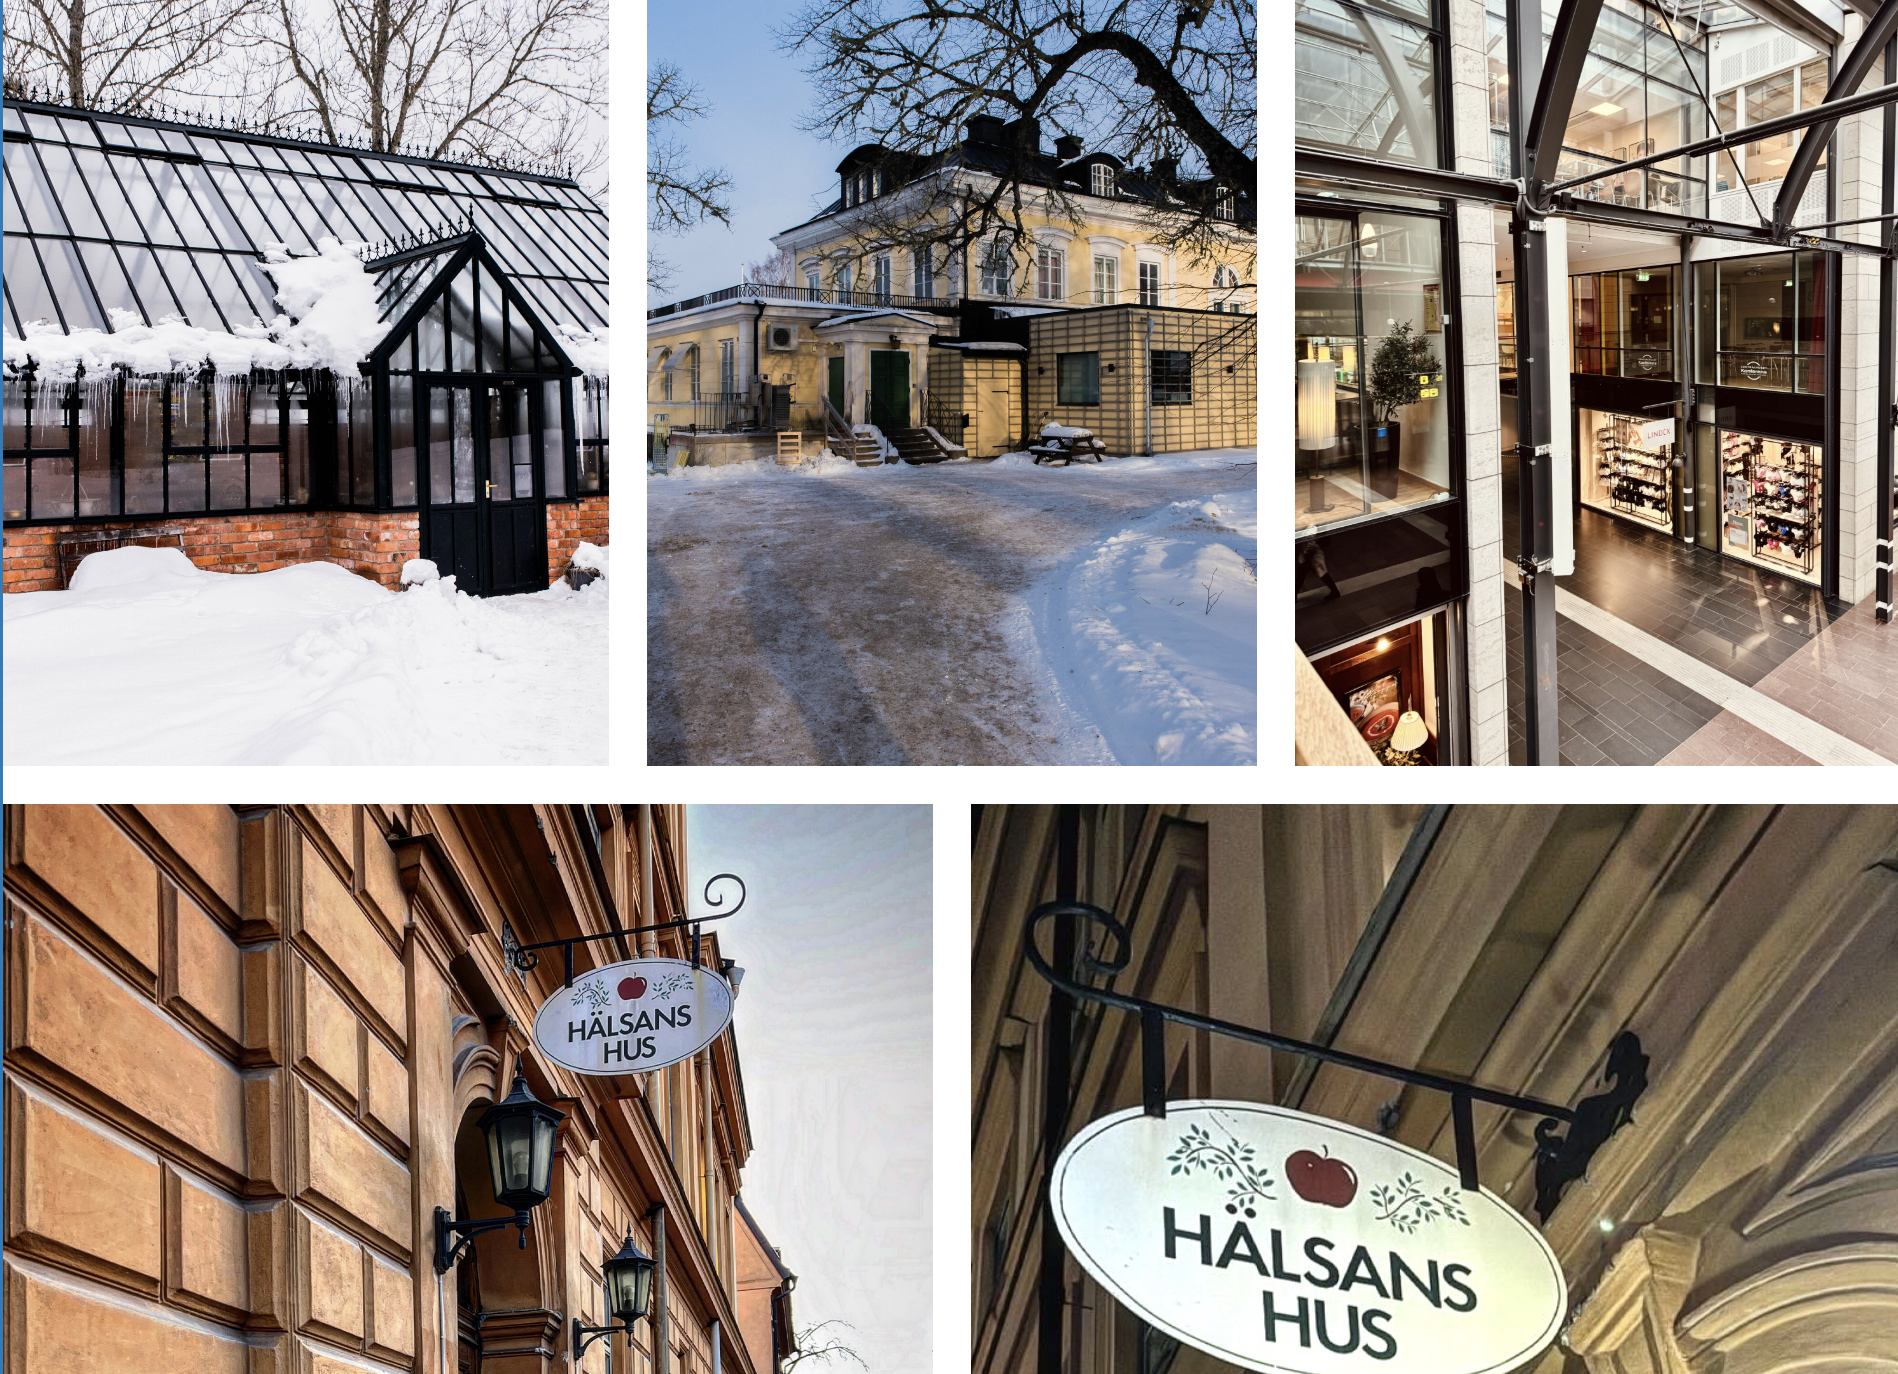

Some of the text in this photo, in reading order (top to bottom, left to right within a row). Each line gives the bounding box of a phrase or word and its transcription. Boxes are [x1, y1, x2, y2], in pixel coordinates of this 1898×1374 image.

[568, 1005, 692, 1042] HÄLSANS
[604, 1036, 656, 1063] HUS
[1164, 1203, 1477, 1313] HÄLSANS
[1263, 1291, 1397, 1360] HUS
